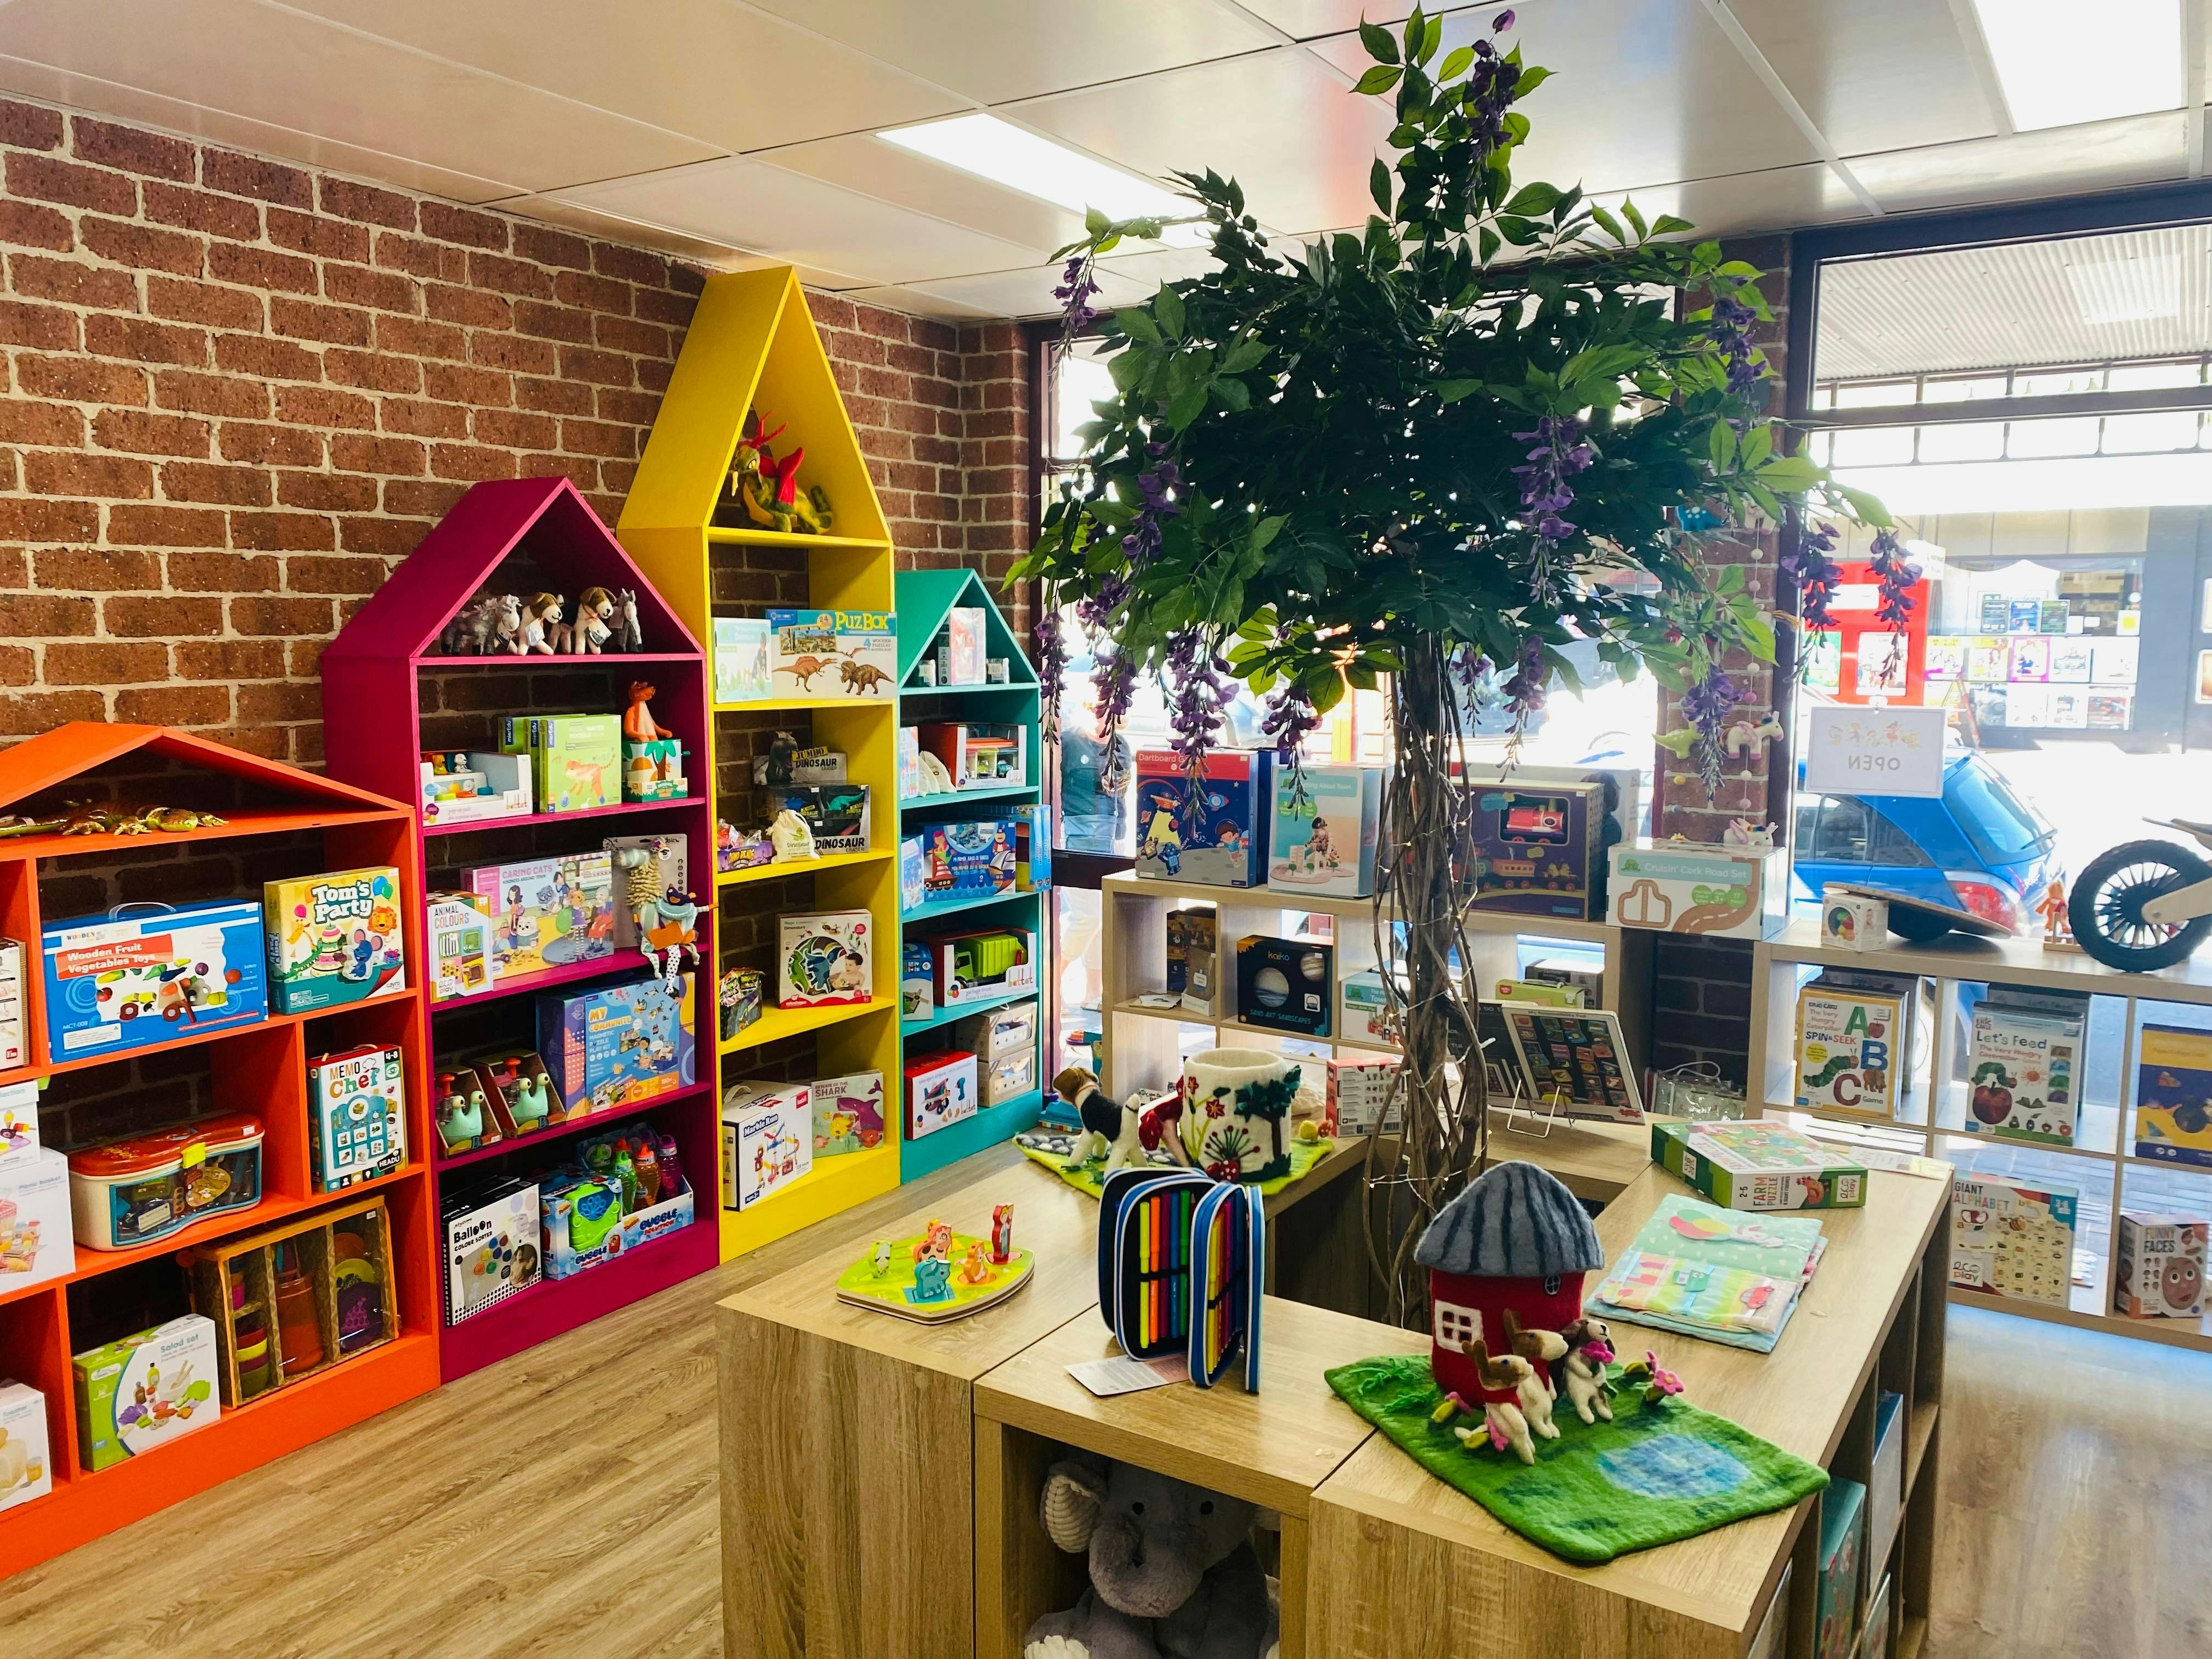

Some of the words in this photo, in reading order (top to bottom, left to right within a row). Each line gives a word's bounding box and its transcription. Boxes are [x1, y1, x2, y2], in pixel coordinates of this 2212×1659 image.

[864, 638, 871, 647] 4
[797, 747, 825, 759] JUMBO
[1138, 753, 1176, 762] Dartboard
[795, 758, 837, 768] DINOSAUR
[815, 837, 865, 850] DINOSAUR
[502, 867, 531, 878] CARING
[533, 865, 553, 874] CATS
[1645, 863, 1679, 873] Cruisin'
[1680, 865, 1702, 874] Cork
[1705, 867, 1729, 878] Road
[1731, 870, 1747, 878] Set
[312, 881, 371, 905] Tom's
[314, 899, 374, 924] Party
[435, 904, 459, 917] ANIMAL
[435, 912, 470, 929] COLOURS
[66, 948, 112, 962] Wooden
[115, 943, 143, 955] Fruit
[1268, 951, 1290, 961] kaiko
[67, 957, 129, 974] Vegetables
[132, 953, 156, 964] Toys
[588, 1006, 608, 1023] MY
[1250, 1009, 1263, 1017] SAND
[1278, 1013, 1312, 1025] SANDSCAPES
[1811, 1017, 1836, 1025] Hungry
[1822, 1009, 1838, 1019] Very
[1844, 1006, 1871, 1039] A
[589, 1030, 615, 1040] MAGNETIC
[589, 1037, 610, 1047] PUZZLE
[1805, 1031, 1829, 1042] SPIN
[1832, 1035, 1857, 1045] SEEK
[1976, 1030, 2009, 1046] Let's
[2013, 1035, 2047, 1049] Feed
[385, 1051, 398, 1059] 4-8
[589, 1046, 603, 1054] PLAY
[1860, 1040, 1888, 1071] B
[1979, 1043, 1993, 1052] The
[1994, 1046, 2012, 1055] Very
[2013, 1048, 2042, 1059] Hungry
[330, 1061, 360, 1080] MEMO
[329, 1068, 380, 1098] Chef
[1833, 1073, 1861, 1107] C
[815, 1085, 847, 1098] SHARK
[1862, 1096, 1883, 1105] Game
[744, 1119, 766, 1137] Marble
[765, 1115, 778, 1126] Run
[379, 1154, 400, 1167] HEADU
[1739, 1186, 1748, 1198] 2-5
[1753, 1177, 1768, 1206] FARM
[1767, 1176, 1779, 1206] PUZZLE
[1849, 1177, 1857, 1199] play
[1954, 1182, 1984, 1195] GIANT
[1953, 1193, 2010, 1212] ALPHABET
[640, 1207, 678, 1231] BUBBLE
[454, 1220, 492, 1244] Balloon
[475, 1231, 493, 1243] SORTER
[2144, 1240, 2175, 1253] FACES
[575, 1245, 608, 1265] BUBBLE
[1953, 1271, 1979, 1283] play
[160, 1338, 184, 1353] Salad
[187, 1334, 199, 1344] set
